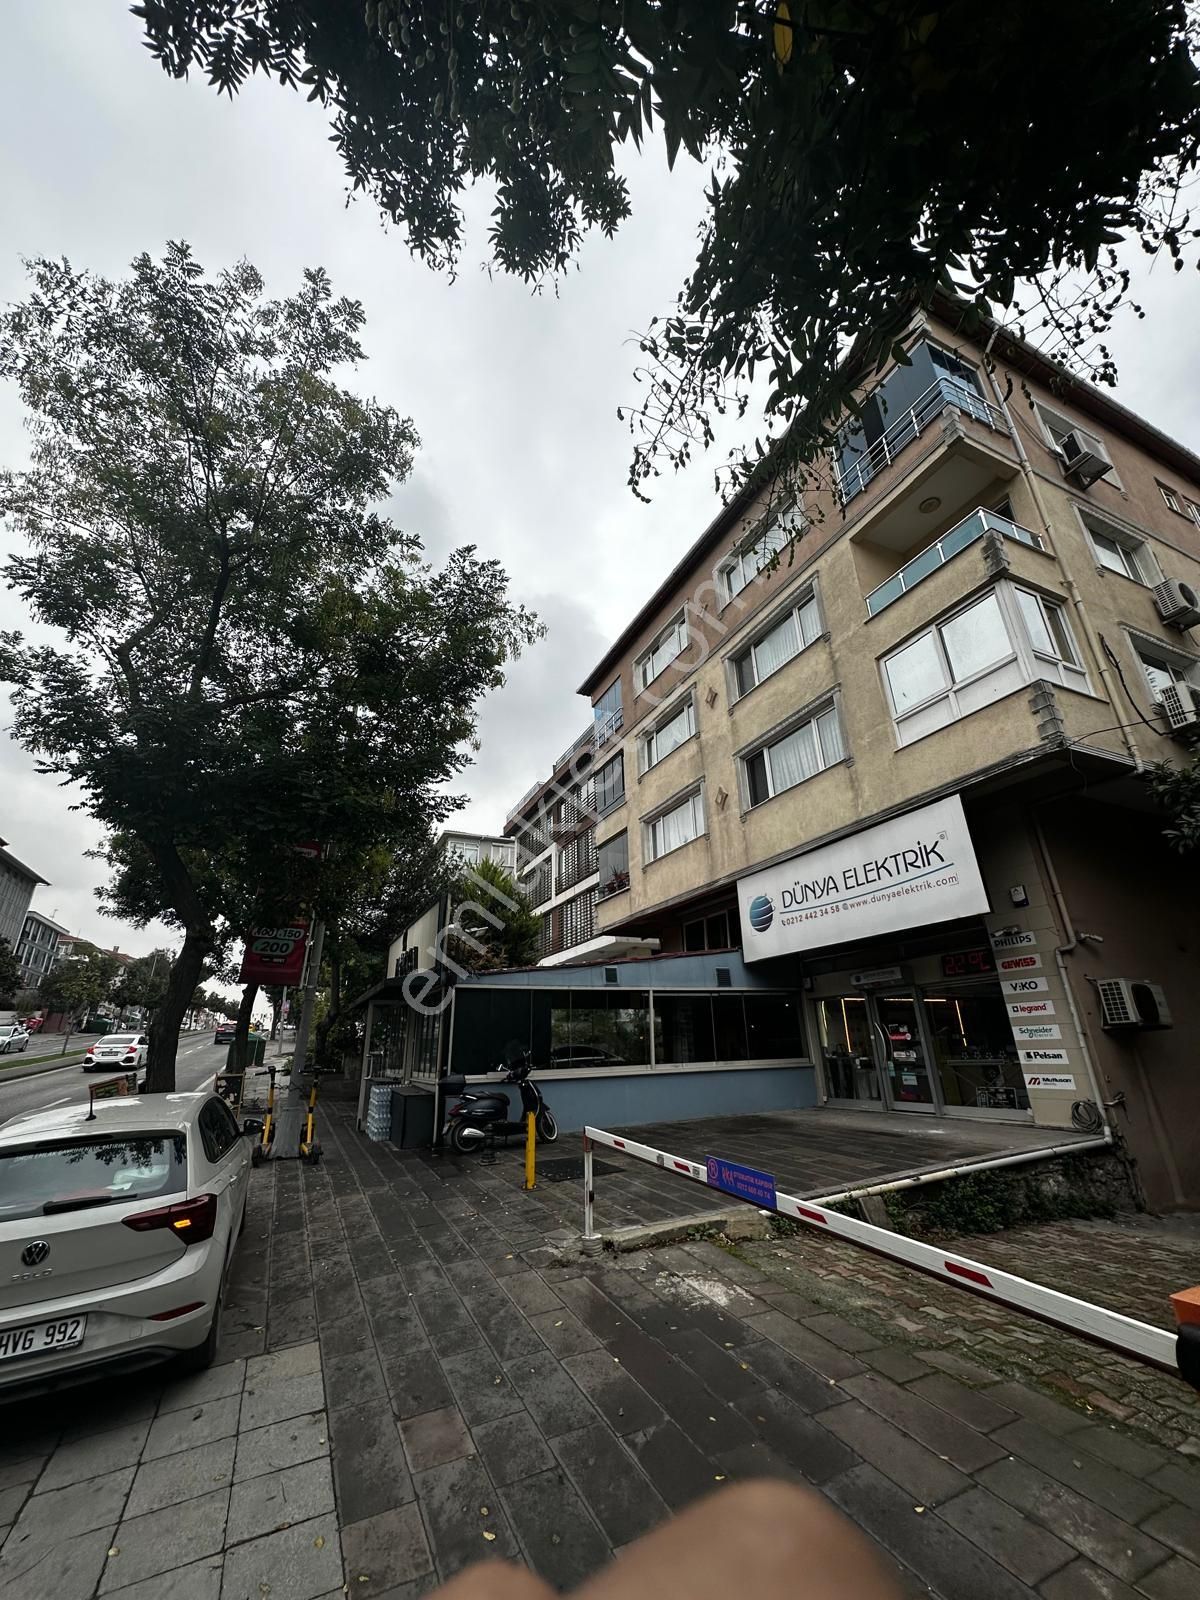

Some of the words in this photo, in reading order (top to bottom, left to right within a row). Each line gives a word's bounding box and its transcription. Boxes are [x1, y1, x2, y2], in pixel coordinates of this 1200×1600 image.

[782, 875, 839, 909] DÜNYA
[843, 840, 945, 890] ELEKTRİK
[786, 914, 803, 926] 0212
[804, 910, 818, 922] 442
[819, 907, 829, 918] 34
[831, 905, 840, 915] 58
[849, 874, 958, 909] www.dunyaelektrik.com
[260, 941, 290, 953] 200
[994, 935, 1032, 948] PHILIPS
[1001, 957, 1036, 969] GEWISS
[1019, 1003, 1047, 1014] legrand
[1019, 1027, 1053, 1038] Schneider
[1033, 1051, 1063, 1059] Pelsan
[43, 1319, 81, 1346] 992
